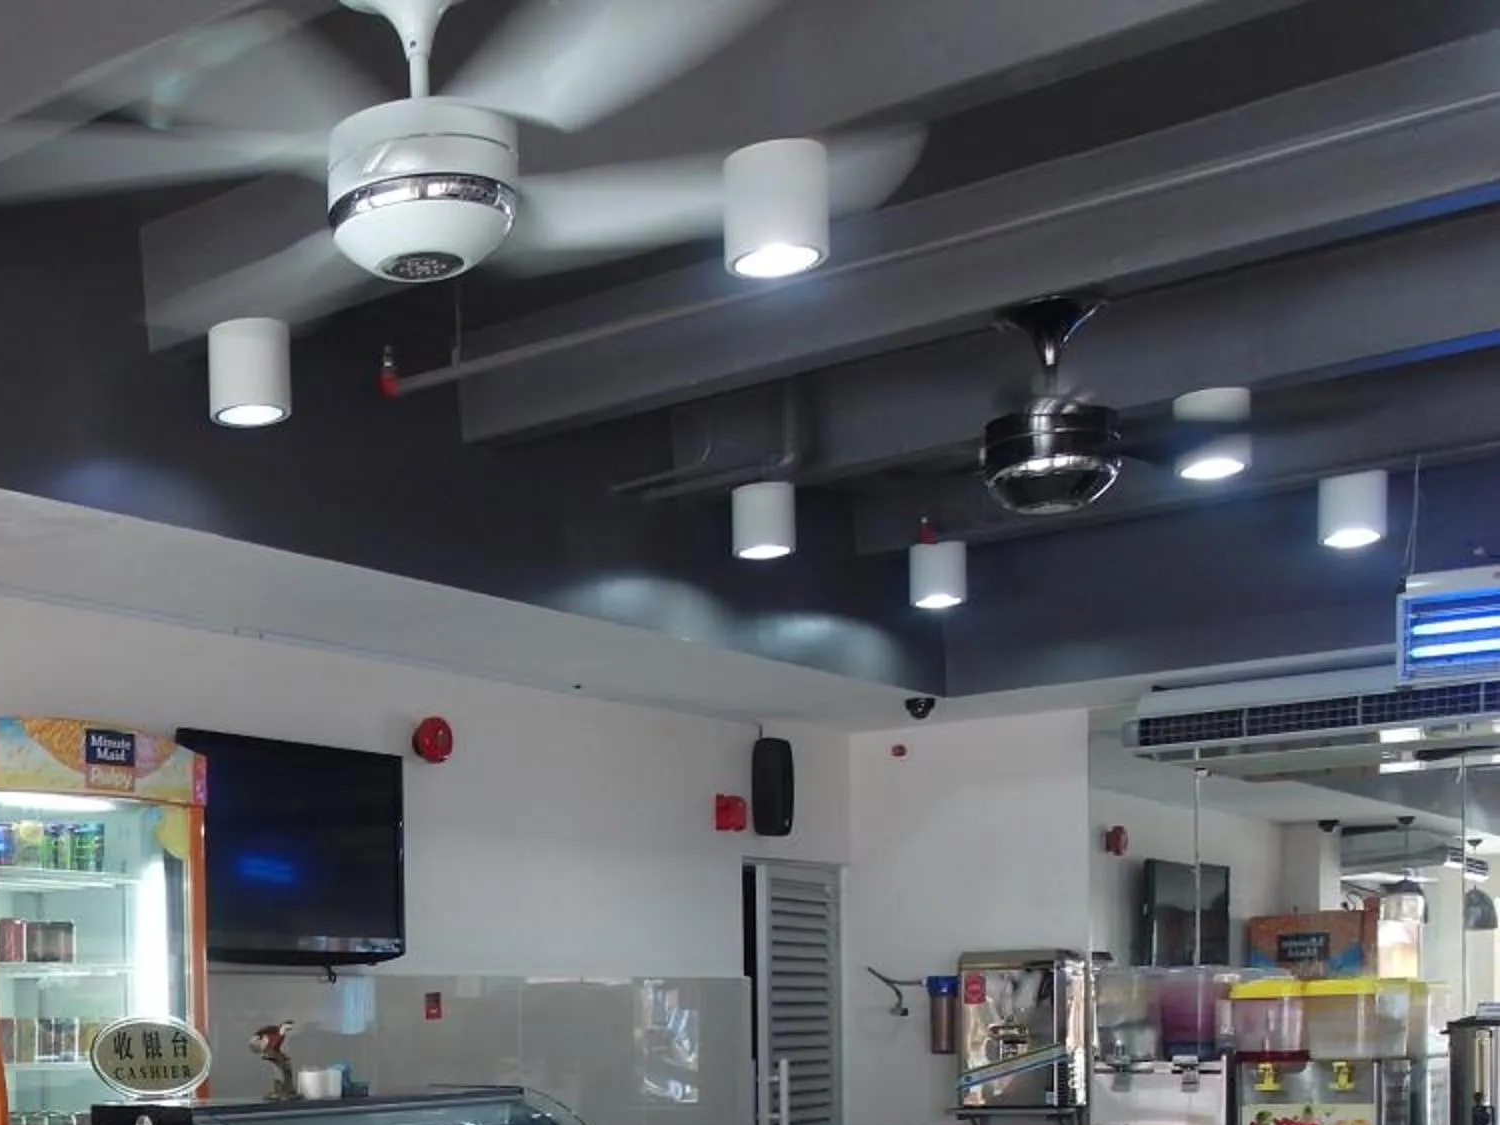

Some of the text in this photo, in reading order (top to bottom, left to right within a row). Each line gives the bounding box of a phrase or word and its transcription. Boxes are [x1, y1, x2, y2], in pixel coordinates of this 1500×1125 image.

[90, 734, 131, 750] Minute
[96, 747, 126, 761] Maid
[113, 1065, 191, 1080] CASHIER
